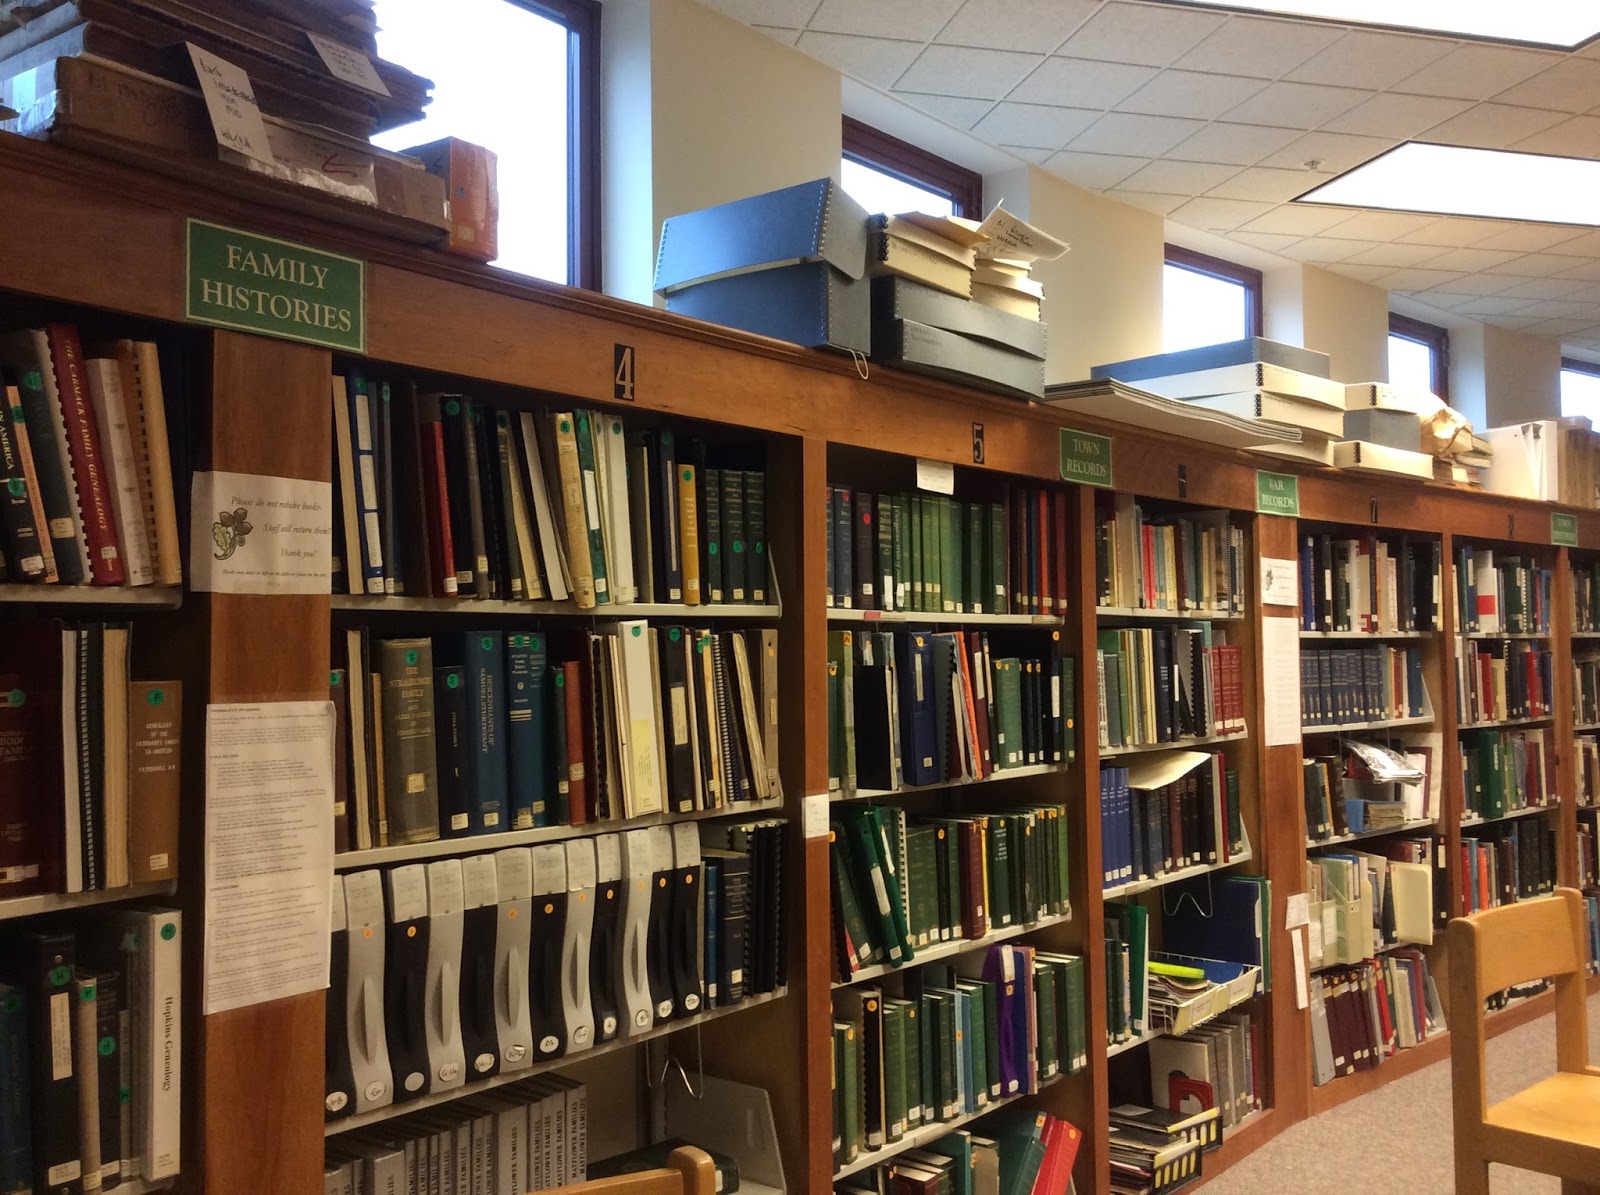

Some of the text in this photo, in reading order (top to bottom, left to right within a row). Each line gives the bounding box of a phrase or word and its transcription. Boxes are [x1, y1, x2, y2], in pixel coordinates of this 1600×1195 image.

[226, 244, 329, 290] FAMILY
[200, 278, 352, 332] HISTORIES
[615, 346, 634, 398] 4
[0, 425, 15, 470] AMERICA
[68, 363, 86, 415] CARMACK
[79, 416, 95, 461] FAMILY
[88, 462, 109, 531] GENEALOGY
[973, 422, 984, 464] 5
[1072, 438, 1100, 456] TOWN
[1066, 458, 1107, 477] RECORDS
[1268, 478, 1284, 492] WAR
[231, 496, 253, 506] Please
[255, 498, 264, 506] do
[267, 500, 277, 508] not
[1261, 493, 1295, 509] RECORDS
[262, 523, 281, 534] Staff
[281, 525, 292, 533] will
[293, 526, 313, 534] return
[280, 548, 317, 559] Thank you!
[162, 997, 173, 1092] Hopkins Geneology
